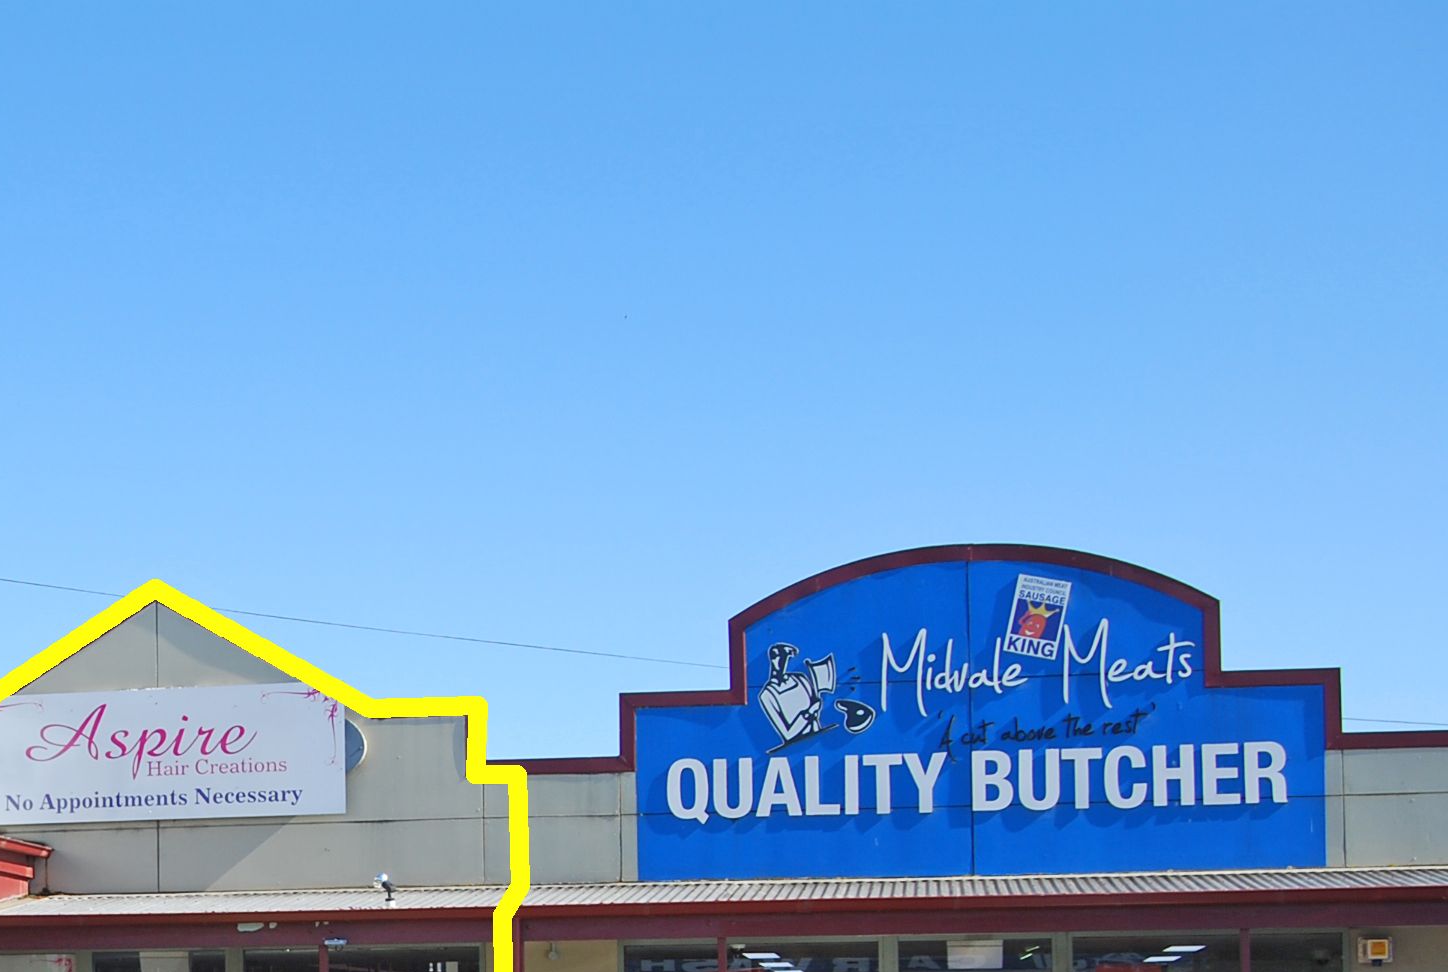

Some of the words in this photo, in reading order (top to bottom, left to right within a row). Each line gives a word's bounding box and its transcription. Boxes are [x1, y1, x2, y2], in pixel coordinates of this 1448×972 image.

[1018, 589, 1067, 606] SAUSAGE
[1006, 636, 1055, 658] KING
[881, 627, 1028, 718] Midvale
[1063, 618, 1195, 709] Meats
[25, 703, 257, 780] Aspire
[960, 719, 995, 746] cut
[1001, 716, 1057, 743] above
[146, 759, 191, 778] Hair
[195, 757, 288, 776] Creations
[666, 751, 953, 824] QUALITY
[971, 741, 1289, 812] BUTCHER
[5, 794, 34, 812] No
[39, 788, 188, 814] Appointments
[194, 786, 304, 806] Necessary
